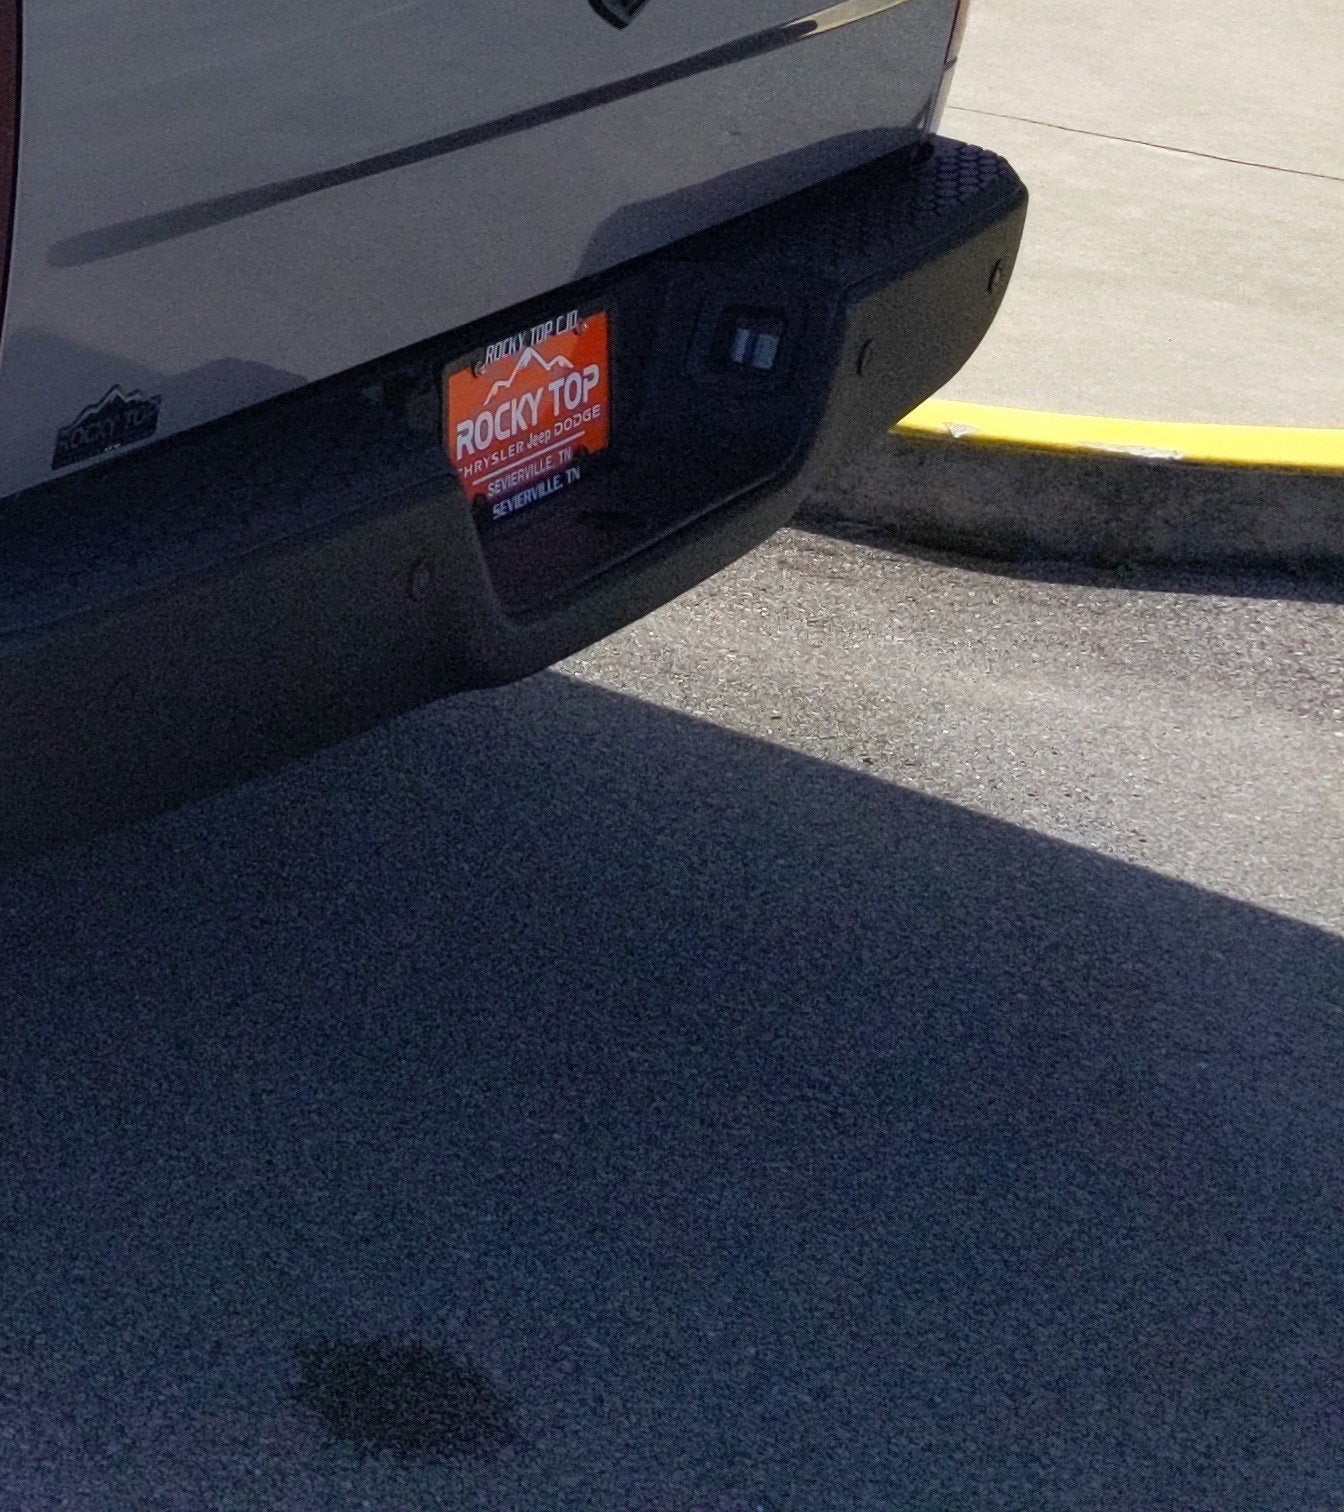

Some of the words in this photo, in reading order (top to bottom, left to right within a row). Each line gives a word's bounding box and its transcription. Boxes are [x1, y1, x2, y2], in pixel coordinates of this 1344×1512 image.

[485, 331, 526, 364] ROCKY
[530, 320, 553, 346] TOP
[456, 388, 544, 460] ROCKY
[549, 364, 600, 416] TOP
[458, 440, 525, 478] HRYSLER
[527, 429, 551, 449] Jeep
[554, 404, 600, 437] DODGE
[559, 446, 572, 464] TN
[566, 466, 580, 484] TN
